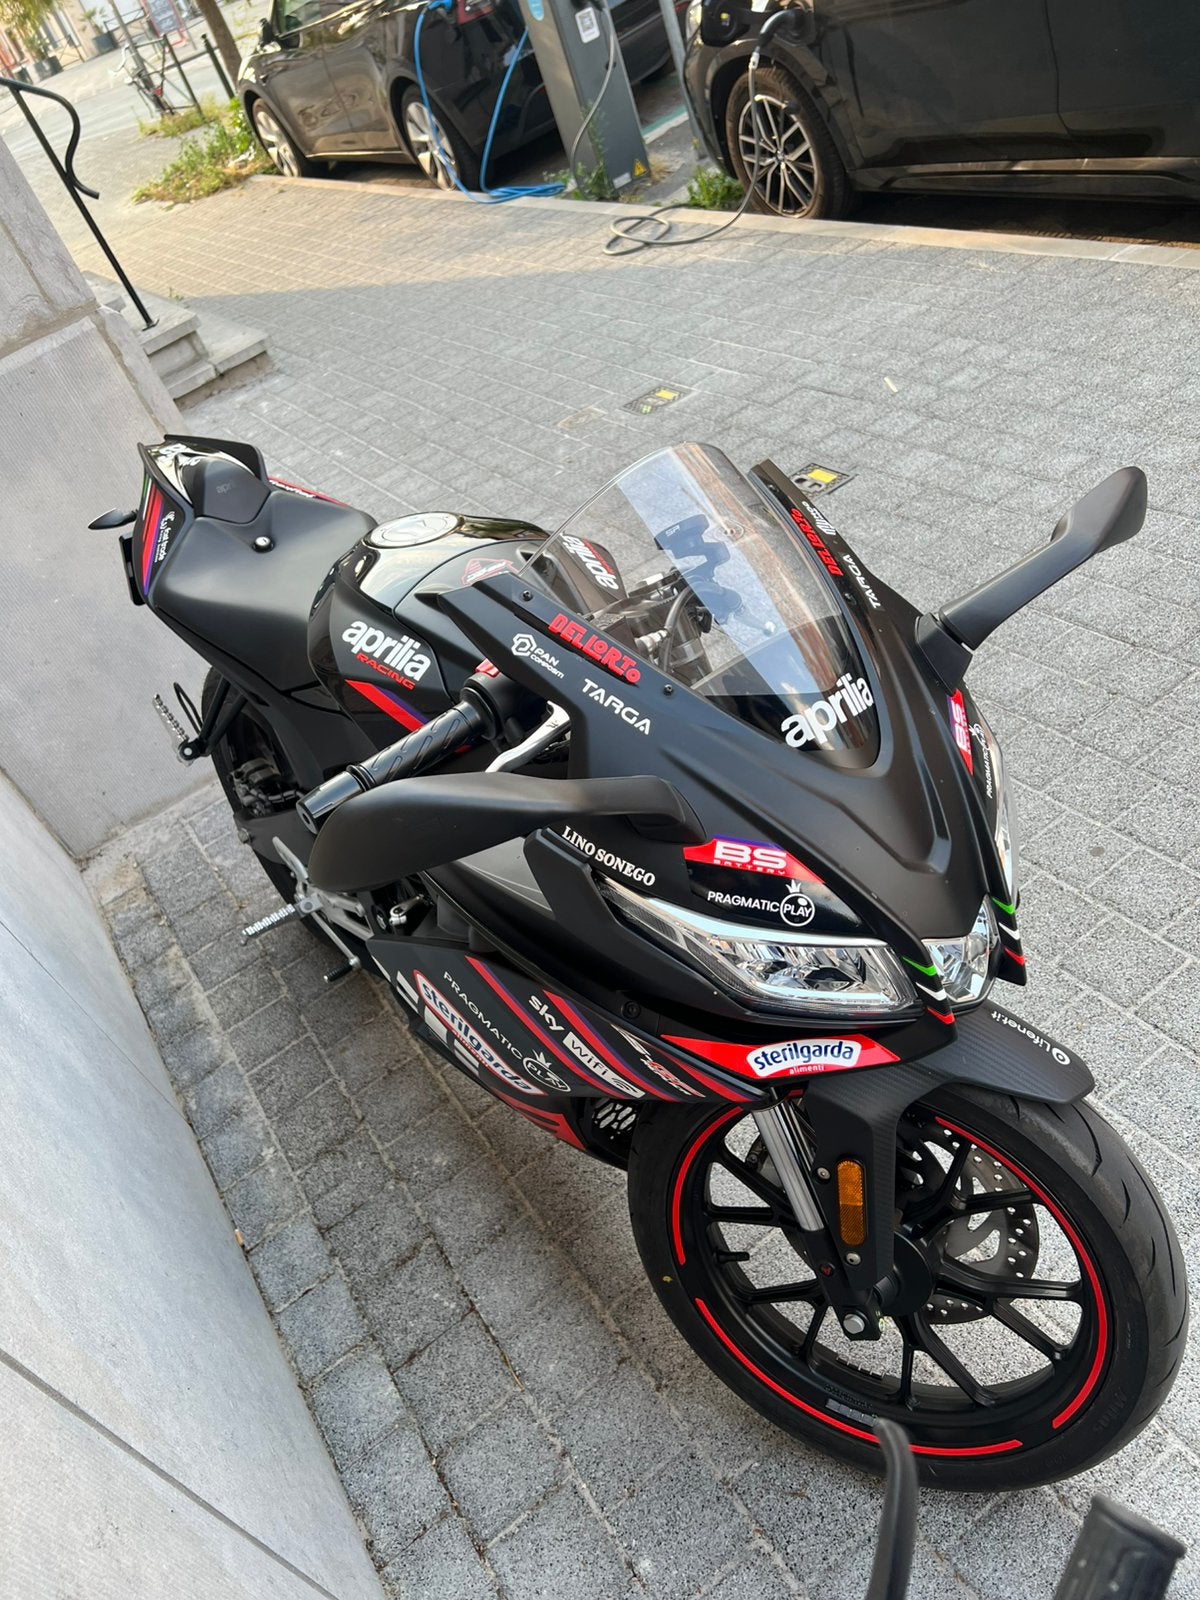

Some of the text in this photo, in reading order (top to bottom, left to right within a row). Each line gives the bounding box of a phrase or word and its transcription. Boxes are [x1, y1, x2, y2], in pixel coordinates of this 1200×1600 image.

[843, 554, 881, 608] TARGA
[342, 620, 431, 682] aprilia
[534, 646, 560, 667] PAN
[356, 652, 416, 691] RACING
[582, 678, 651, 735] TARGA
[781, 672, 874, 748] aprilia
[562, 826, 656, 887] LINO SONEGO
[713, 859, 786, 876] BATTERY
[714, 841, 787, 870] BS
[707, 890, 812, 918] PRAGMATIC PLAY
[443, 971, 523, 1060] PRAGMATIC
[528, 995, 565, 1031] sky
[421, 983, 532, 1090] sterilgarda
[754, 1041, 854, 1070] sterilgarda
[789, 1064, 825, 1075] alimenti
